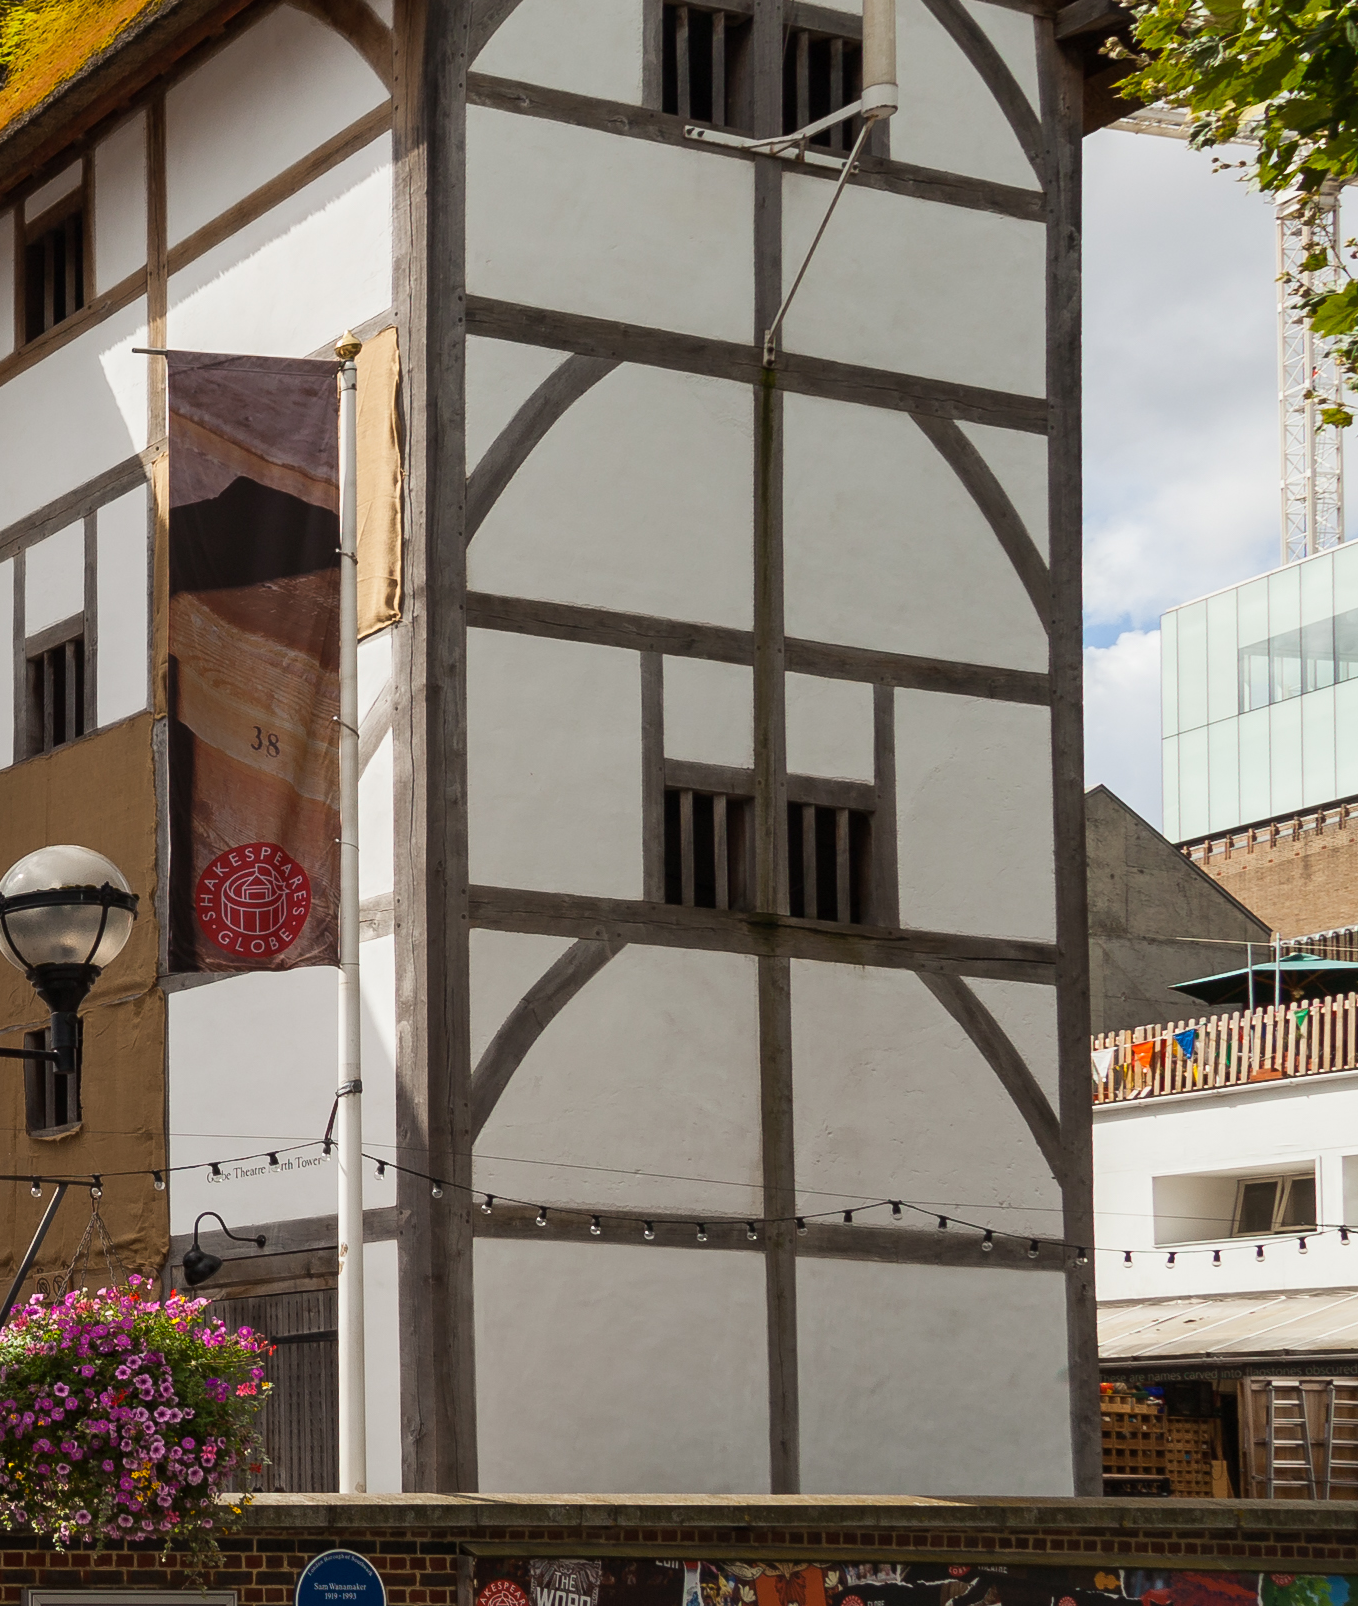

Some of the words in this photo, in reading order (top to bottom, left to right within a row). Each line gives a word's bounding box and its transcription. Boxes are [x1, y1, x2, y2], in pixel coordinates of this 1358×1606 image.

[251, 726, 280, 757] 38
[200, 847, 306, 921] SHAKESPEARE'S
[218, 928, 293, 953] GLOBE
[206, 1169, 231, 1183] Gbe
[233, 1166, 266, 1179] Theatre
[295, 1157, 322, 1169] Tower
[1129, 1374, 1145, 1382] are
[1148, 1372, 1181, 1382] names
[1183, 1369, 1218, 1380] carved
[1221, 1368, 1242, 1378] into
[1305, 1362, 1358, 1376] obscured
[313, 1582, 329, 1590] Sam
[329, 1582, 367, 1591] Wanamaker
[554, 1571, 577, 1591] THE
